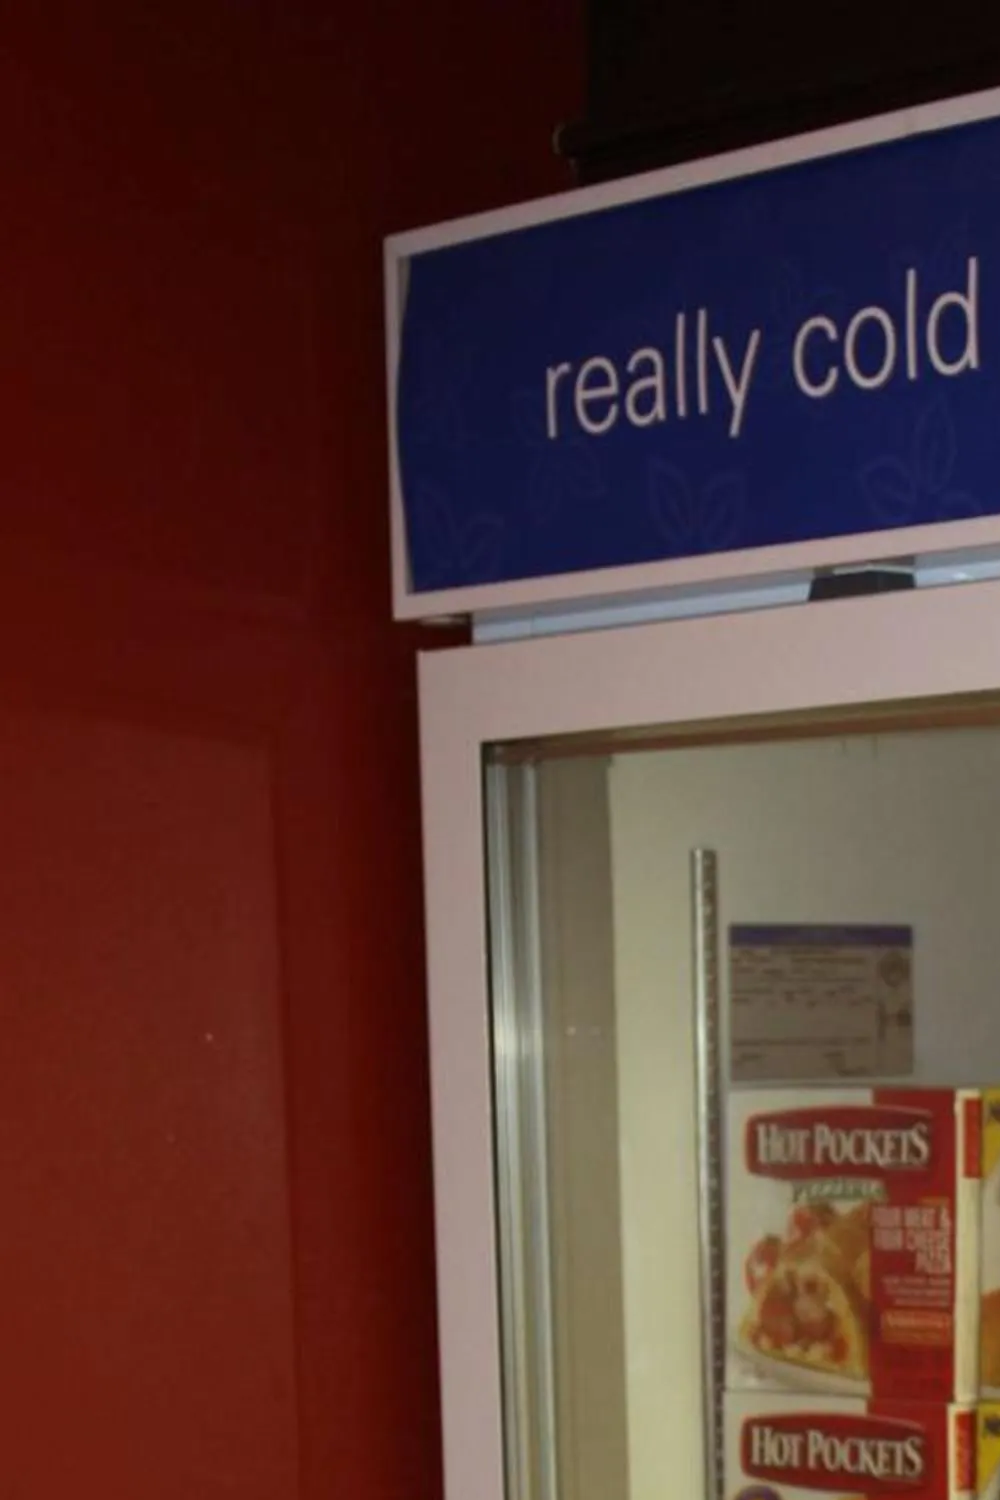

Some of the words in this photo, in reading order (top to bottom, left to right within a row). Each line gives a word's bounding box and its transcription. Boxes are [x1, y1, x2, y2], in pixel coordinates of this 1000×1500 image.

[546, 306, 760, 439] really
[793, 256, 979, 398] cold
[757, 1124, 811, 1165] HOT
[814, 1122, 930, 1169] POCKETS
[752, 1426, 803, 1467] HOT
[807, 1429, 924, 1478] POCKETS
